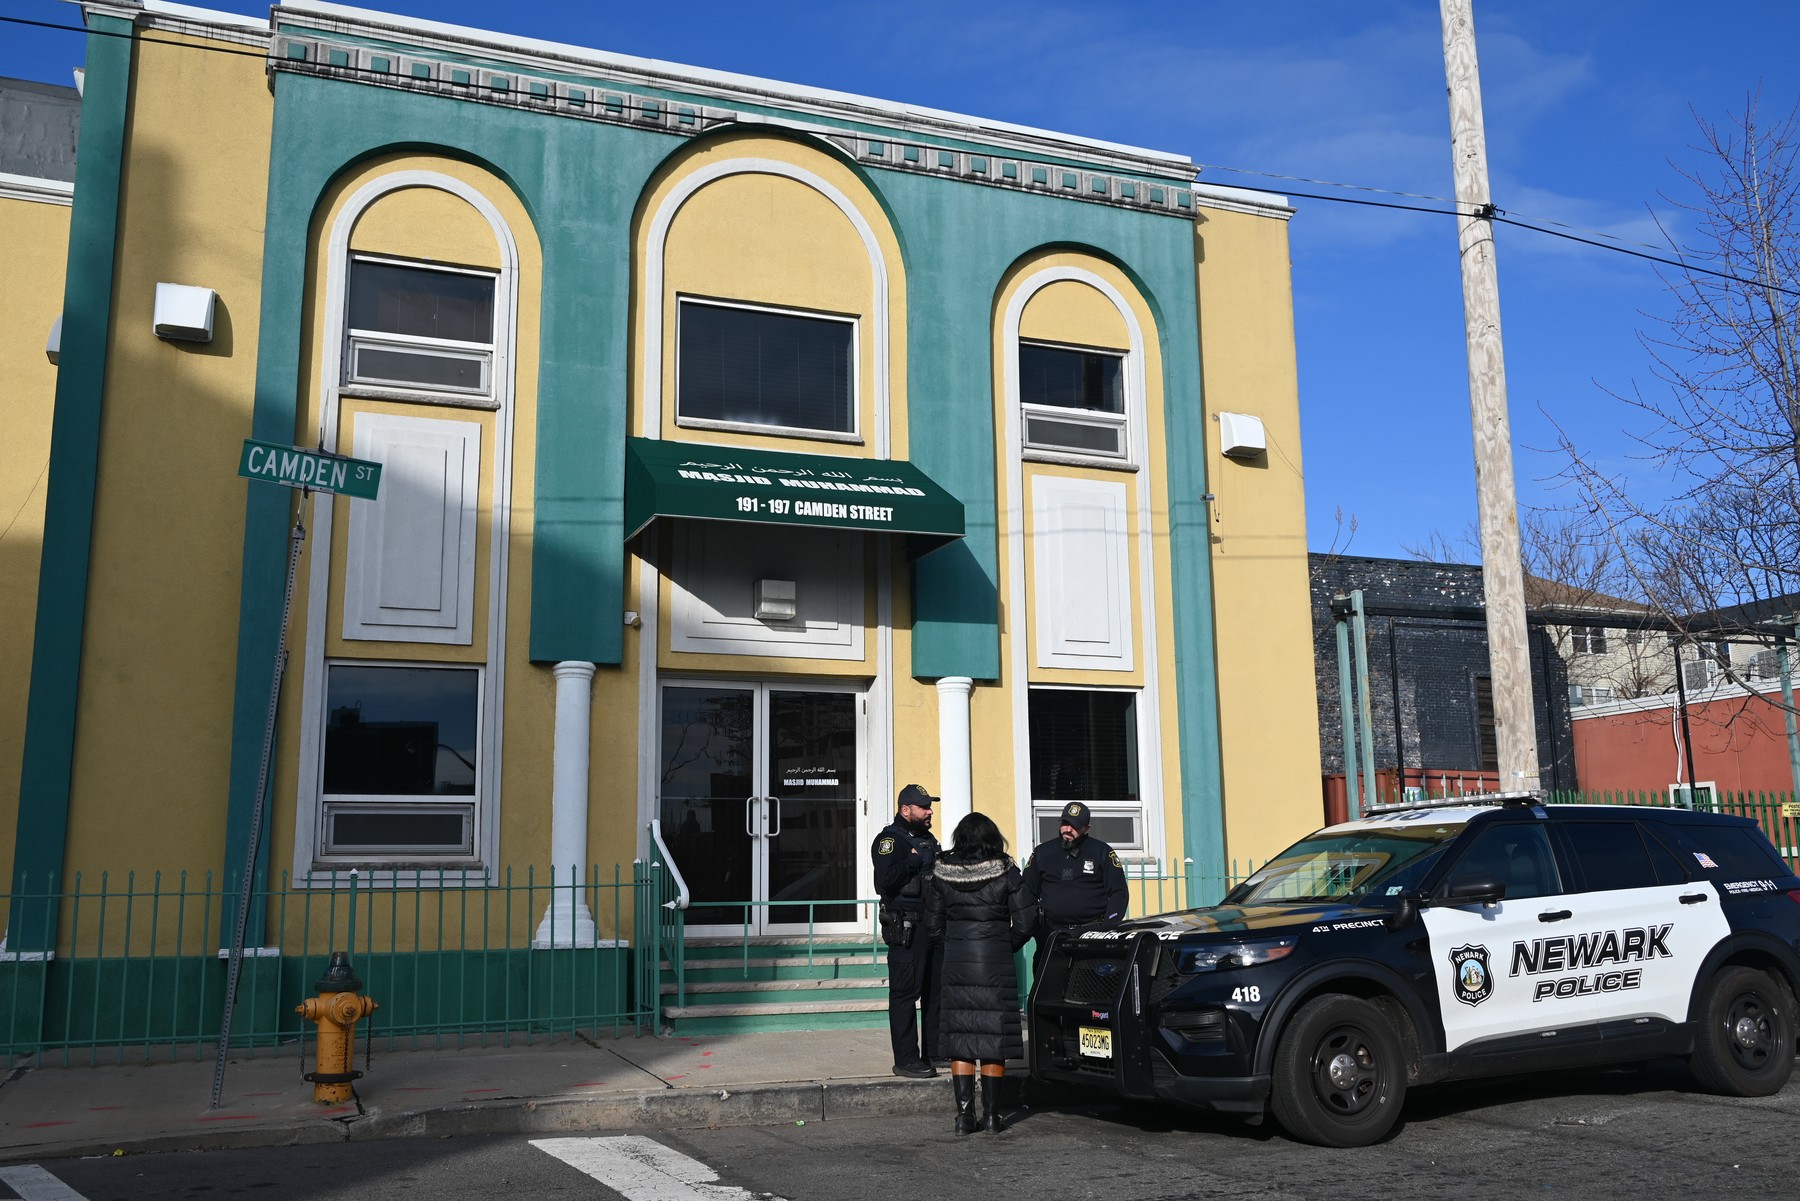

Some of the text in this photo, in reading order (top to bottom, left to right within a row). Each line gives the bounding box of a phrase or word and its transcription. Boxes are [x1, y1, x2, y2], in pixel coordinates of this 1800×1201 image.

[248, 446, 374, 488] CAMDEN ST
[679, 461, 743, 470] الرحيم
[752, 466, 815, 477] الرحمن
[822, 470, 853, 479] الله
[677, 469, 926, 496] MASJID MUHAMMAD
[736, 497, 758, 512] 191
[768, 498, 790, 514] 197
[795, 500, 847, 518] CAMDEN
[849, 505, 893, 521] STREET
[783, 778, 839, 786] MASJID MUHAMMAD
[1758, 880, 1778, 890] 9-1-1
[1332, 919, 1385, 931] PRECINCT
[1125, 930, 1184, 940] PCE
[1509, 923, 1674, 977] NEWARK
[1455, 951, 1484, 964] NEWARK
[1533, 968, 1642, 1002] POLICE
[1231, 985, 1261, 1002] 418
[1461, 988, 1487, 1000] POLICE
[1081, 1033, 1110, 1050] 45023MG
